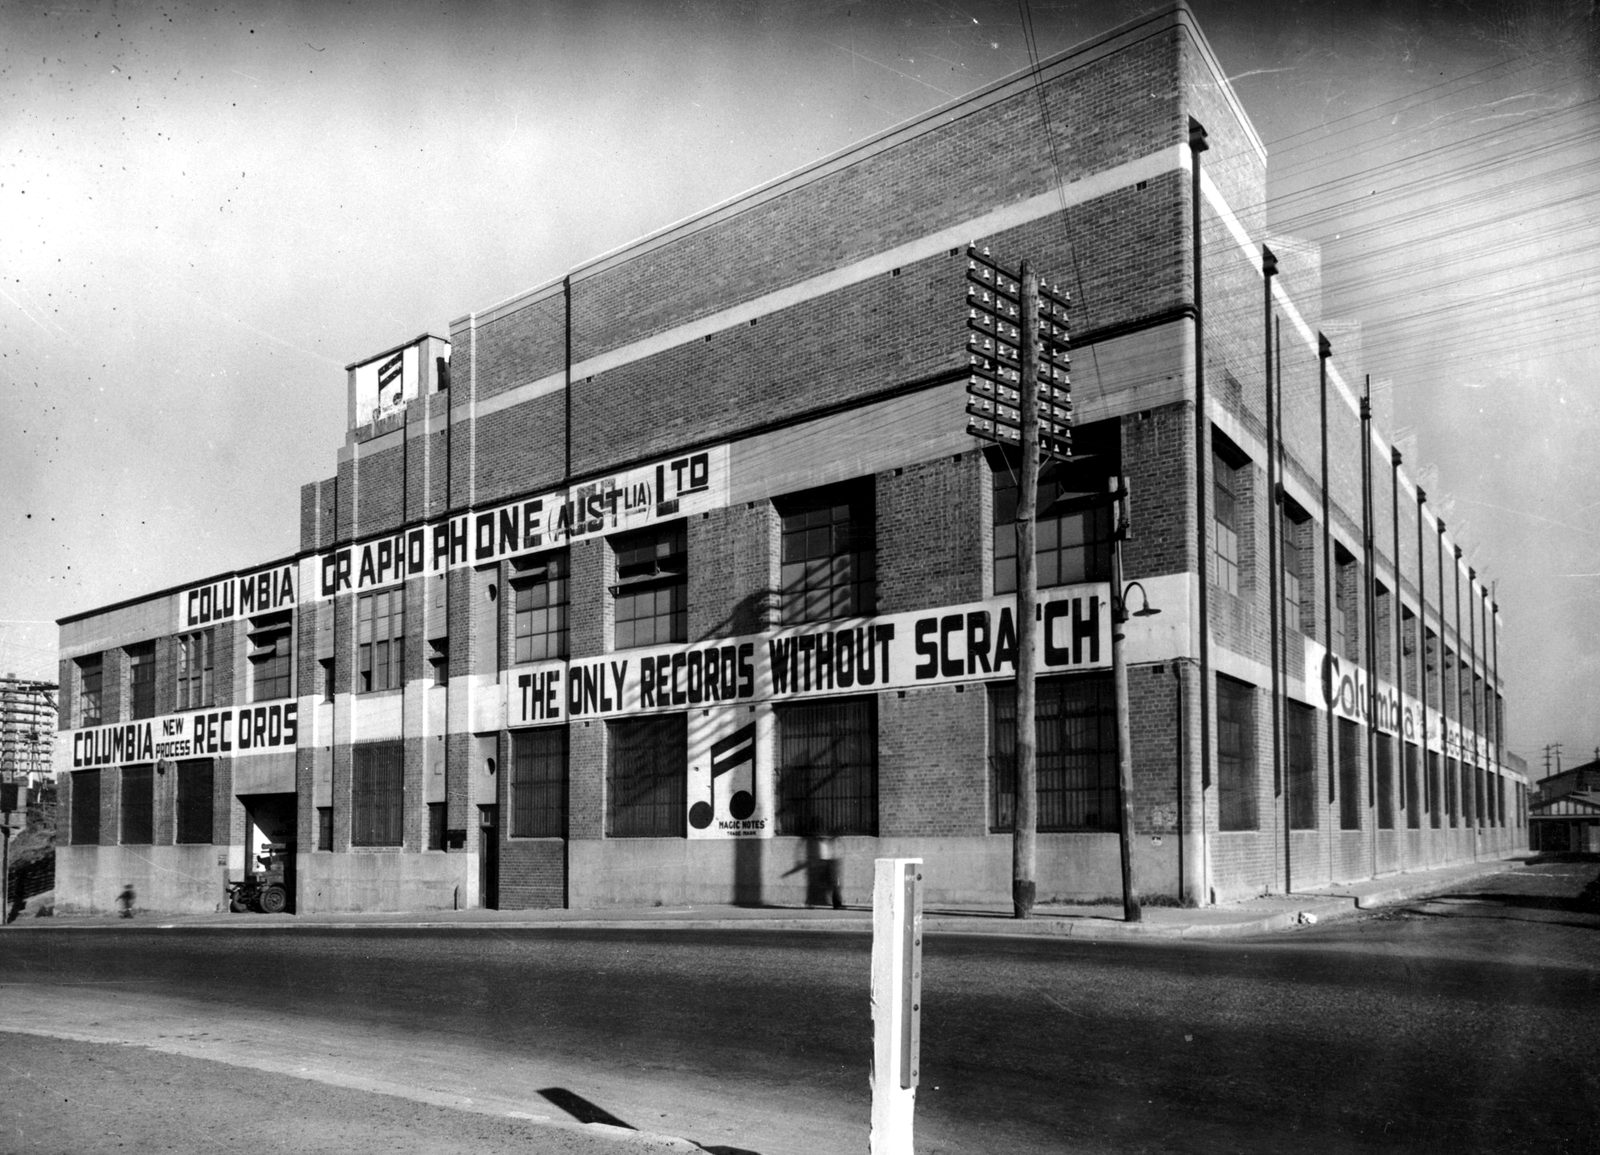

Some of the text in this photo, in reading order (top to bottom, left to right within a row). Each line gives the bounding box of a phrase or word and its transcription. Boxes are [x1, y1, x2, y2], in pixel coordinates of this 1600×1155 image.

[187, 566, 295, 627] COLUMBIA
[321, 499, 543, 597] GRAPHOPHONE
[656, 452, 709, 518] LTD
[518, 595, 1100, 722] THE ONLY RECORDS WITHOUT SCRACH
[1321, 652, 1415, 740] Columba
[73, 702, 298, 768] COLUMBIA NEW PROCESS RECORDS
